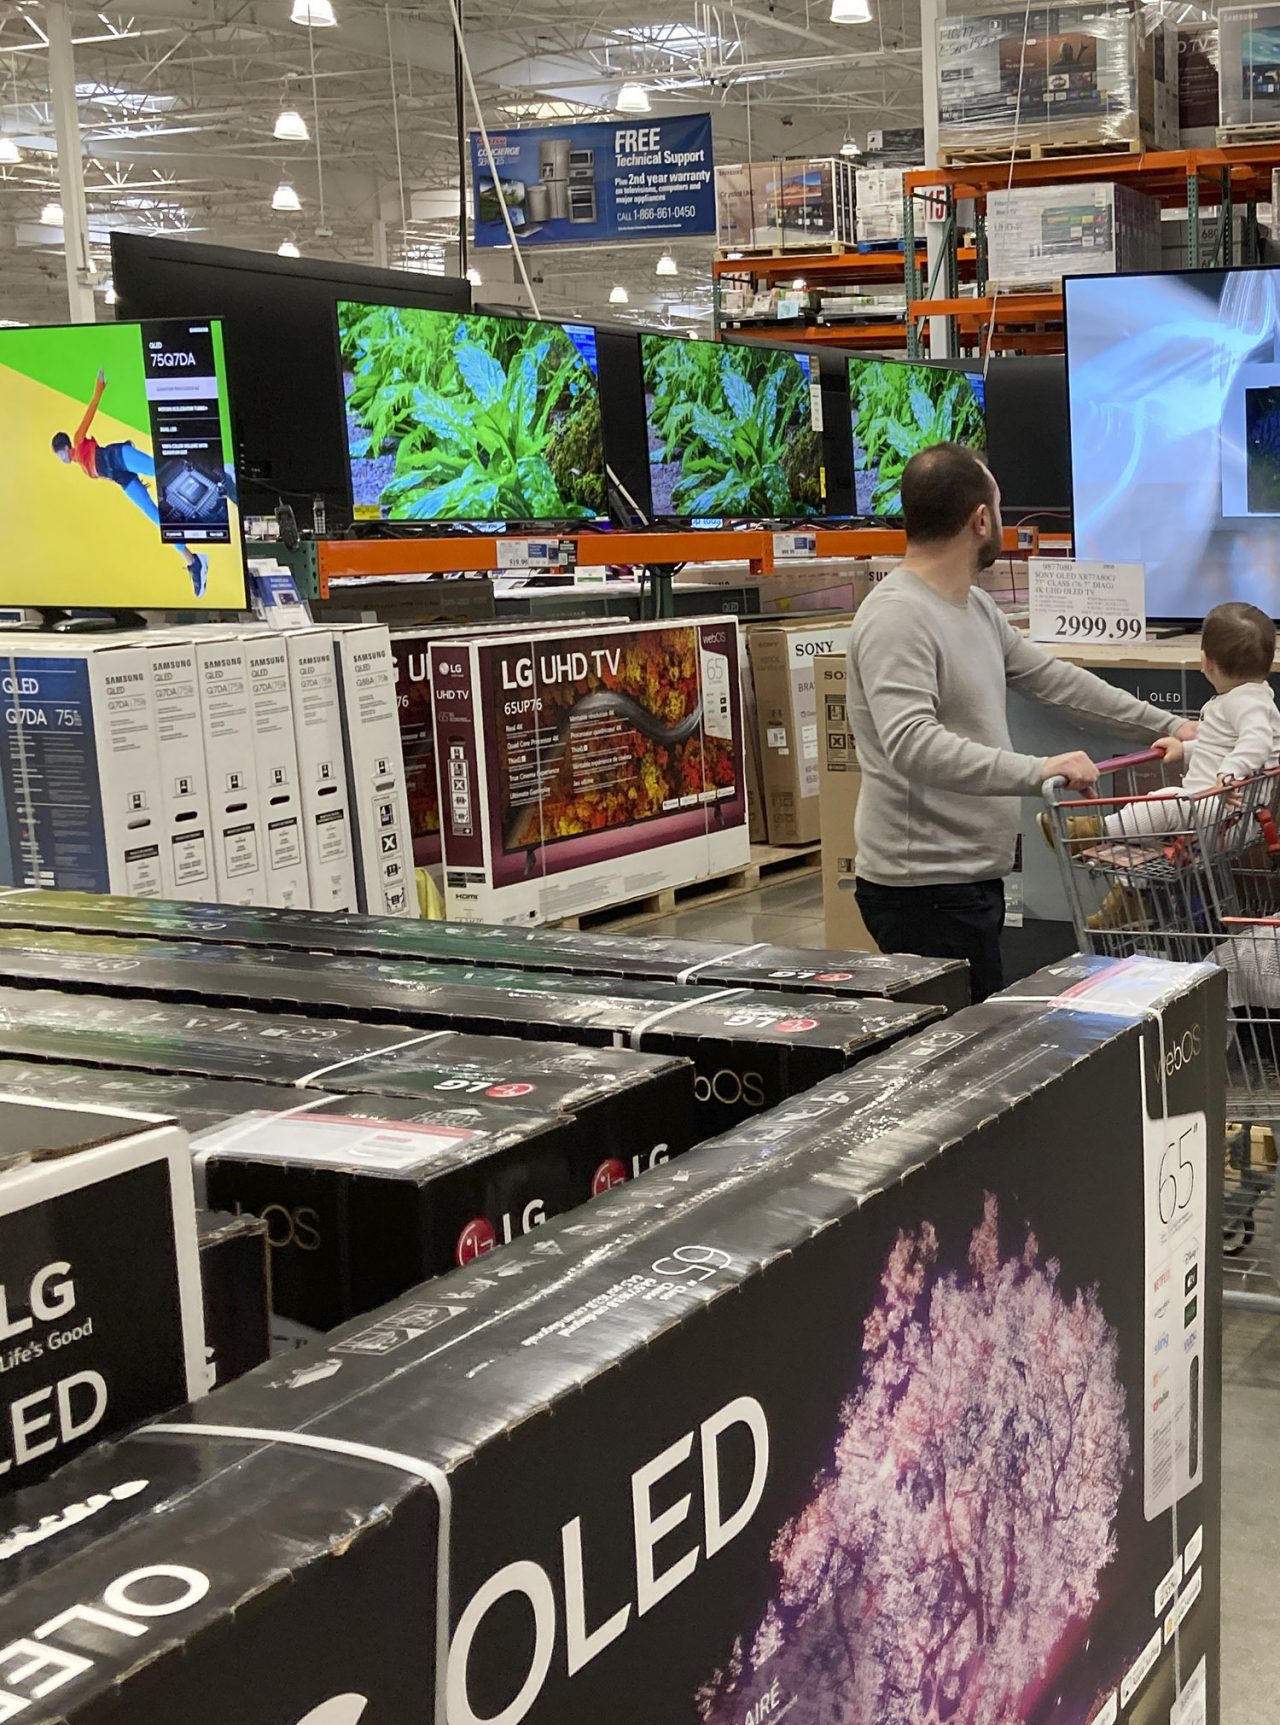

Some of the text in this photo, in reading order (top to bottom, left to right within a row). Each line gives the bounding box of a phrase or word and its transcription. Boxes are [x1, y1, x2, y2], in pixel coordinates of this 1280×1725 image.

[615, 127, 661, 153] FREE
[615, 149, 705, 167] Technical Support
[615, 169, 711, 187] Plus 2nd year warranty
[658, 184, 688, 193] computers
[689, 182, 701, 190] and
[615, 194, 666, 205] major appliances
[617, 205, 696, 222] CALL 1-866-861-0450
[150, 352, 196, 368] 75Q7DA
[1056, 572, 1077, 580] OLED
[1047, 579, 1114, 590] CLASS DIAG)
[1063, 588, 1084, 596] OLED
[1055, 614, 1142, 640] 2999.99
[703, 632, 727, 645] webOS
[795, 640, 834, 658] SONY
[250, 656, 285, 667] SAMSUNG
[298, 655, 330, 666] SAMSUNG
[353, 650, 386, 663] SAMSUNG
[153, 659, 192, 671] SAMSUNG
[204, 657, 242, 669] SAMSUNG
[354, 663, 371, 673] QLED
[450, 664, 462, 673] LG
[501, 648, 621, 690] LG UHD TV
[154, 672, 173, 682] QLED
[205, 670, 224, 680] QLED
[251, 668, 268, 678] QLED
[300, 667, 315, 676] QLED
[824, 670, 847, 681] SO
[105, 673, 144, 685] SAMSUNG
[2, 677, 39, 695] QLED
[106, 686, 125, 696] QLED
[436, 690, 469, 700] UHD TV
[1150, 691, 1181, 703] OLED
[504, 698, 543, 716] 65UP76
[5, 707, 48, 726] Q7DA
[507, 742, 520, 750] Quad
[520, 740, 531, 748] Core
[768, 970, 817, 979] LG
[724, 1015, 778, 1028] LG
[433, 1079, 495, 1094] LG
[0, 1261, 76, 1341] LG
[0, 1317, 93, 1373] Life's Good
[0, 1369, 108, 1475] ED
[446, 1395, 769, 1725] OLED
[0, 1564, 210, 1725] OLE
